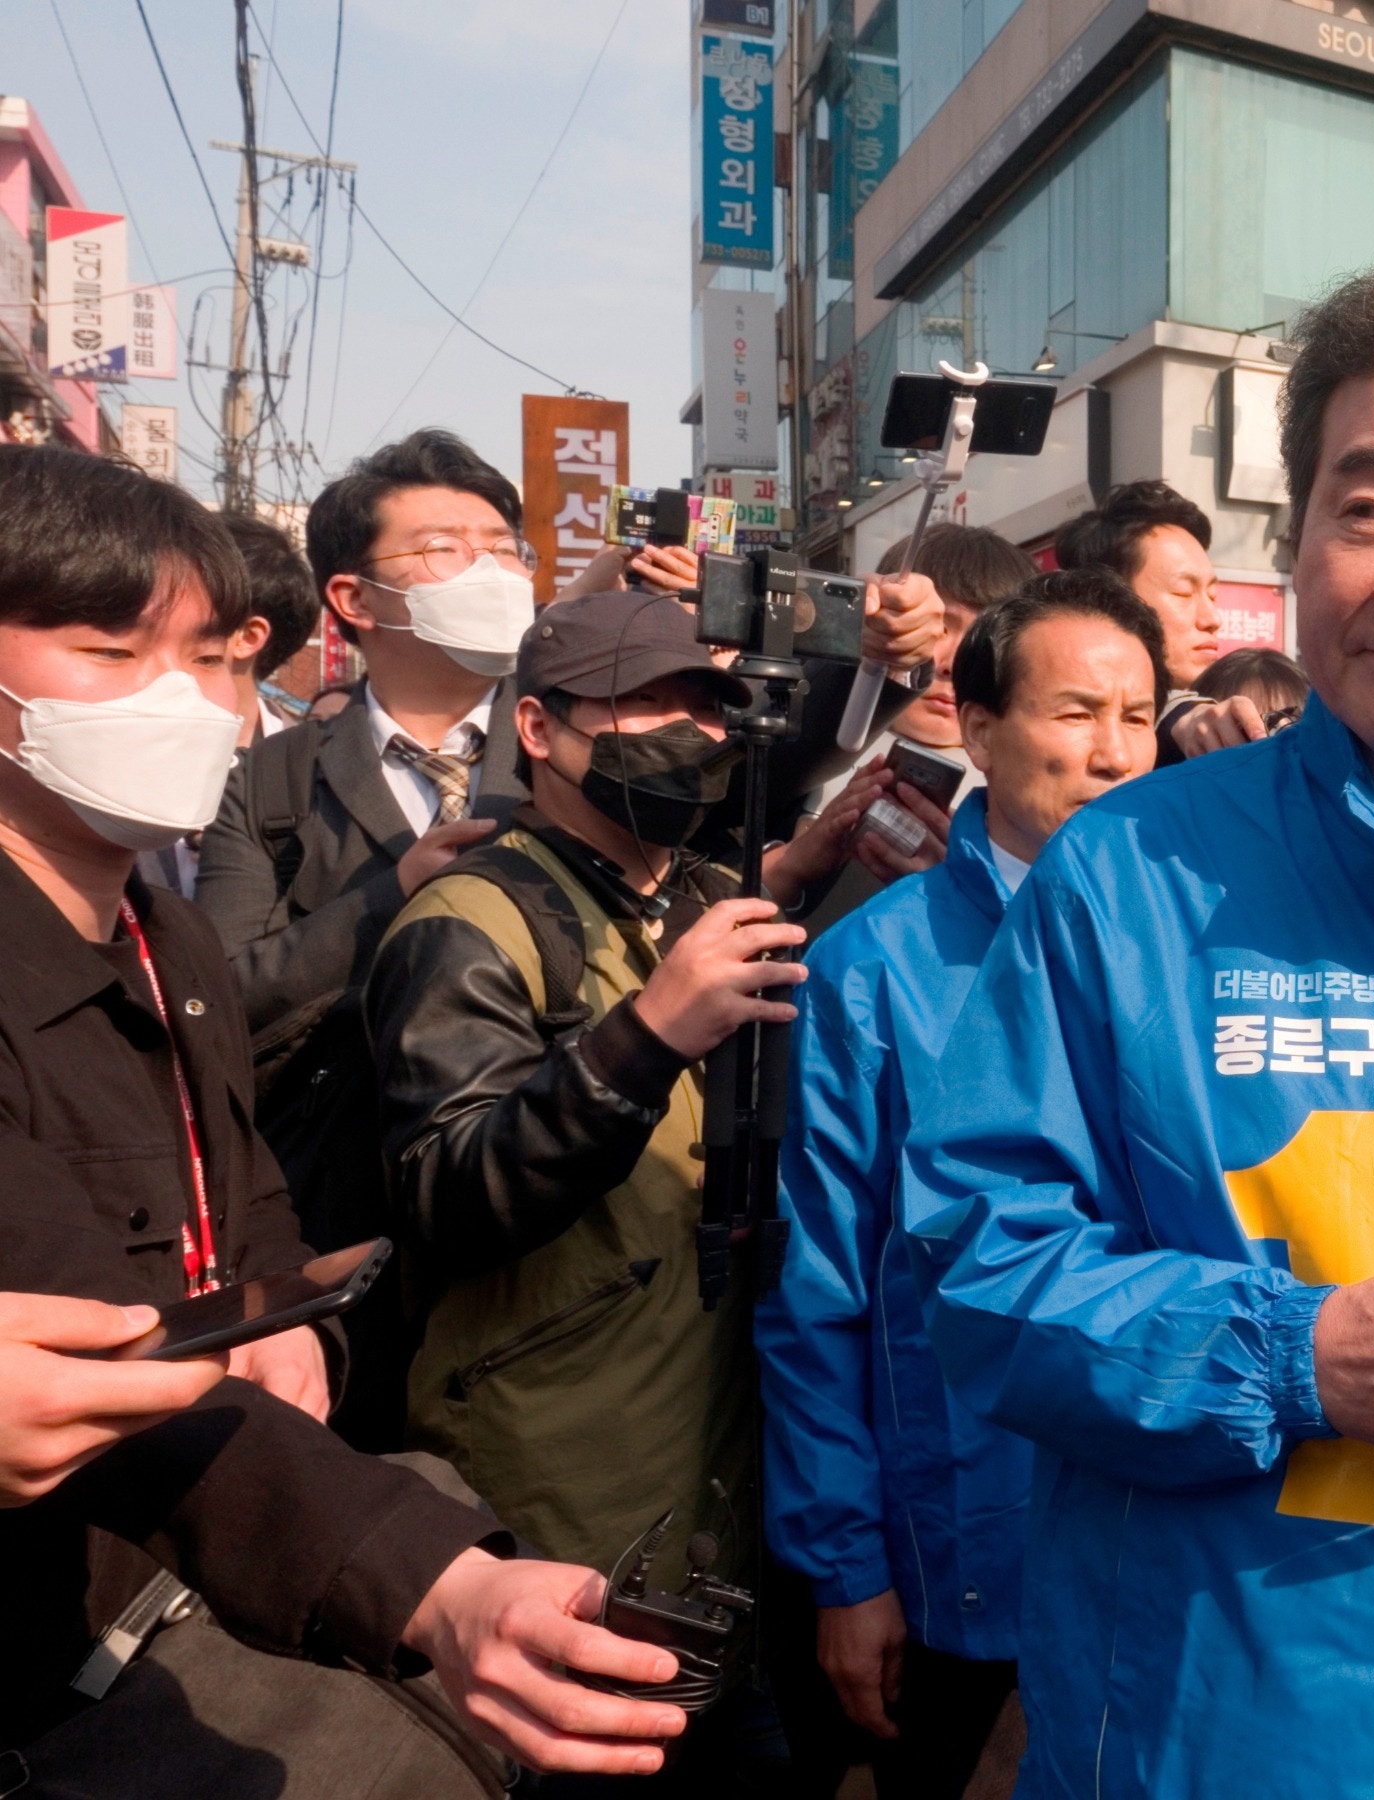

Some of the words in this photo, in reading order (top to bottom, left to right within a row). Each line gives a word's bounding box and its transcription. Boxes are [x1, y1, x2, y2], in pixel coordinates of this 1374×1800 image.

[745, 4, 770, 26] B1
[718, 75, 763, 236] 정형외과
[133, 292, 156, 368] 韩服出租
[733, 337, 752, 443] 온누리약국
[554, 428, 618, 595] 적선
[194, 1157, 208, 1203] CHOSUN
